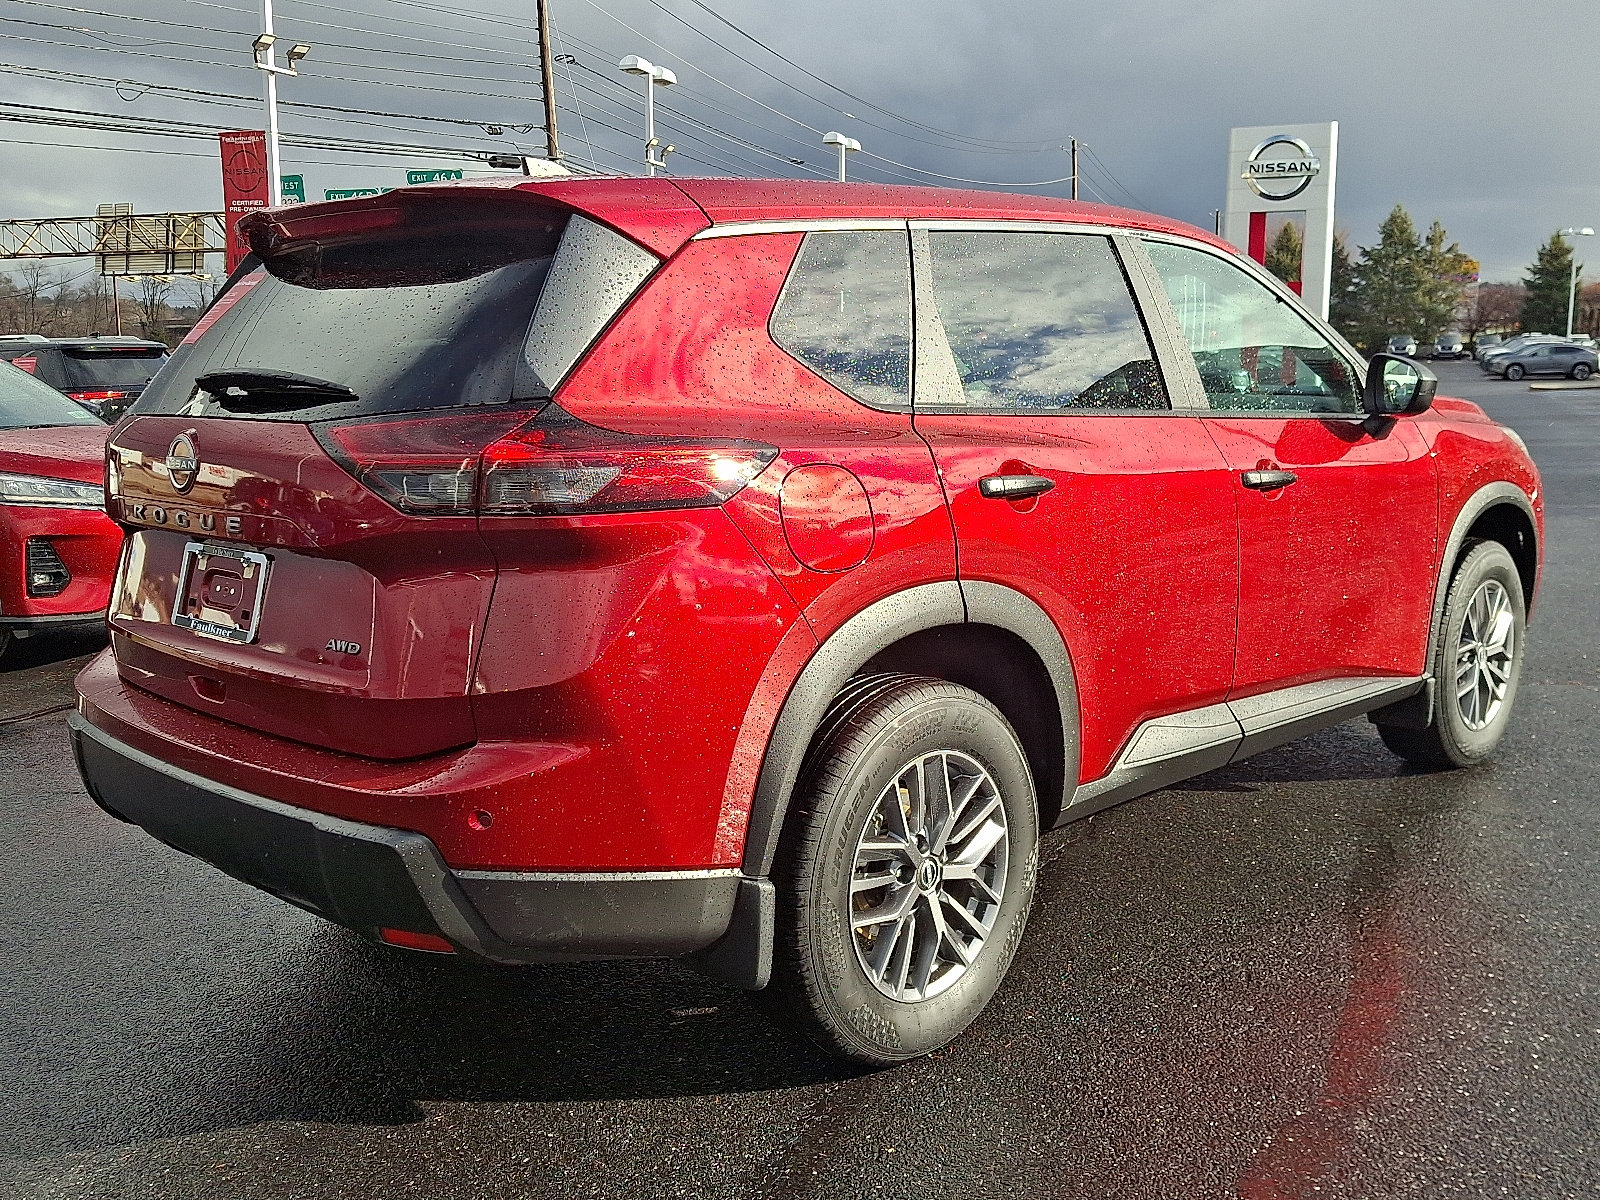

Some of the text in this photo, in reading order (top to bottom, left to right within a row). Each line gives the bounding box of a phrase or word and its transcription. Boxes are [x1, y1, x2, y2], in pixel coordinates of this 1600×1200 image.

[1249, 162, 1311, 174] NISSAN
[281, 180, 299, 190] EST
[133, 504, 242, 534] ROGUE
[190, 619, 233, 637] Faulkner
[325, 638, 361, 655] AWD
[831, 774, 871, 887] CRUGEN
